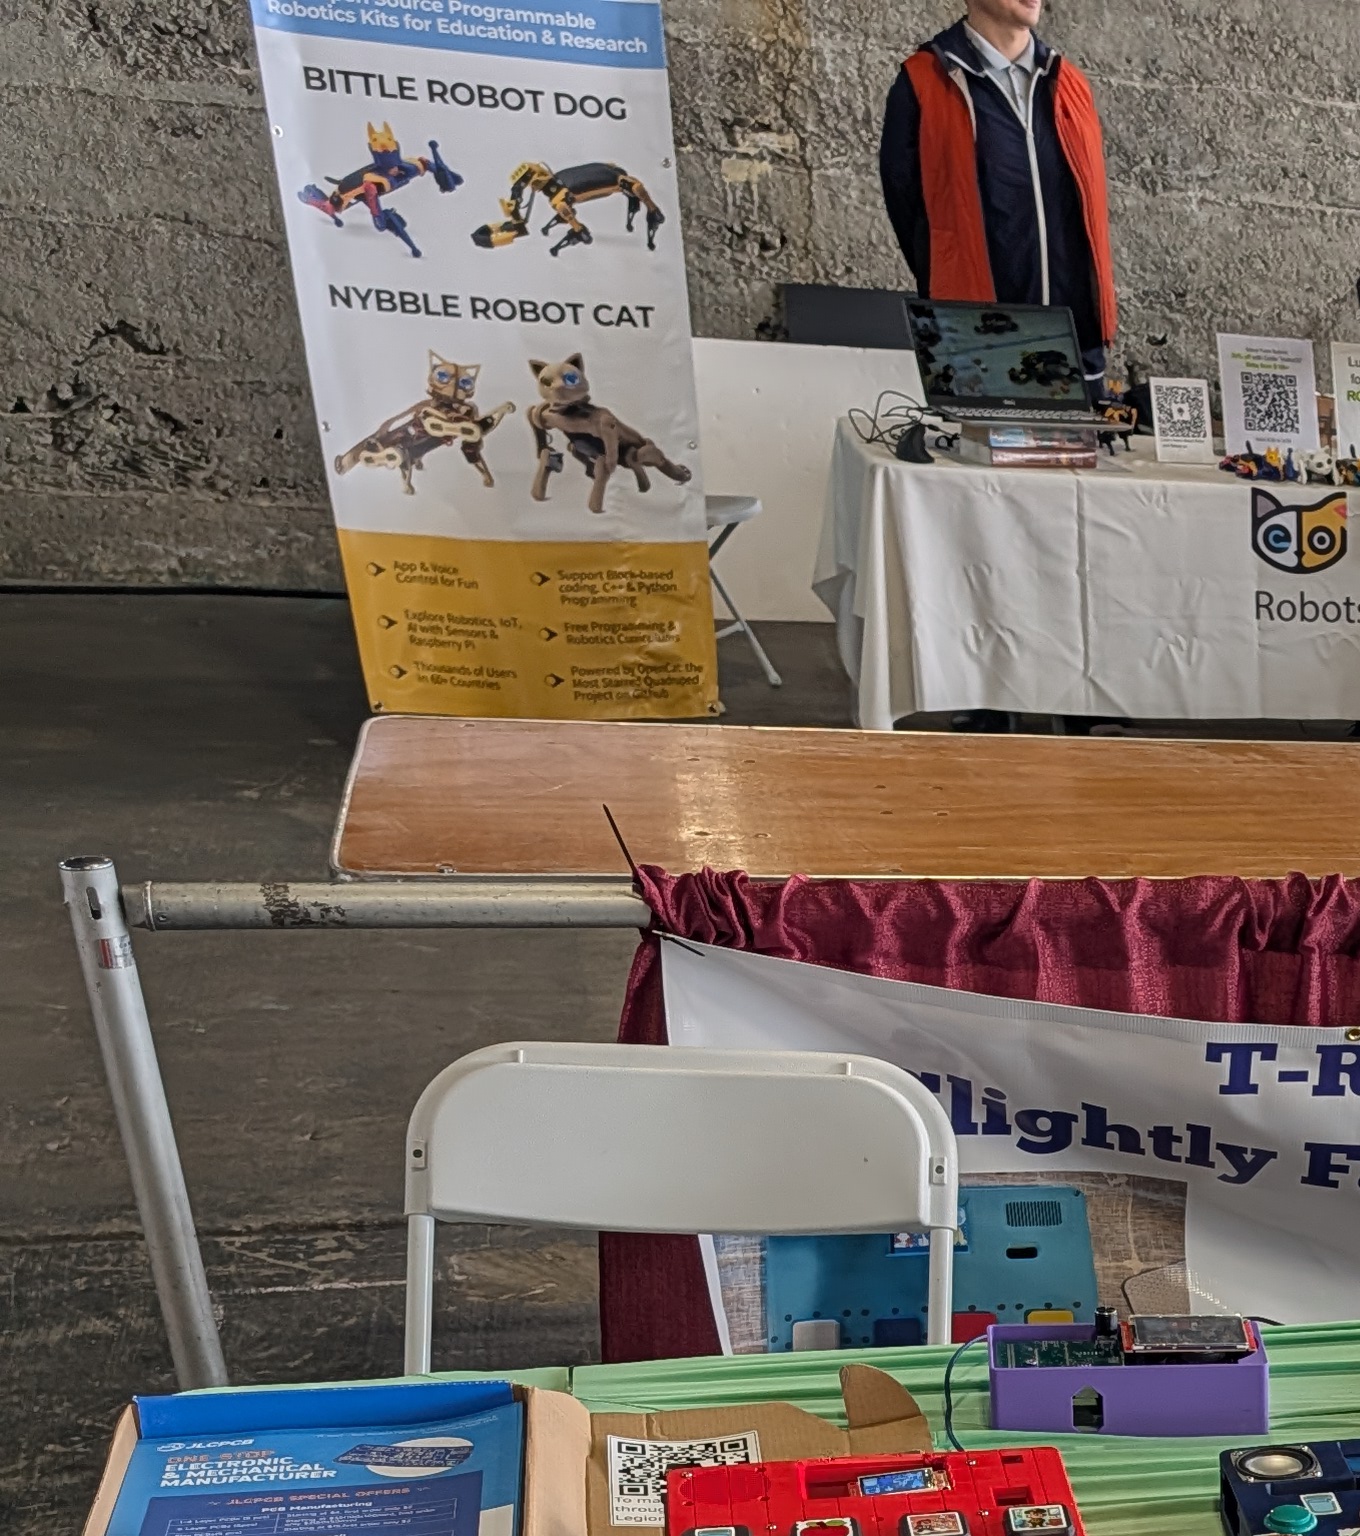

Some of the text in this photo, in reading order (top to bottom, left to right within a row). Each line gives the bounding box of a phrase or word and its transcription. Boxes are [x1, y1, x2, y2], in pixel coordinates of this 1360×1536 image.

[448, 1, 597, 30] Programmable
[267, 1, 648, 54] Robotics Kits for Education & Research
[303, 66, 628, 120] BITTLE ROBOT DOG
[328, 284, 655, 329] NYBBLE ROBOT CAT
[186, 1439, 254, 1449] JLCPCB
[165, 1456, 294, 1472] ELECTRONIC
[186, 1463, 325, 1478] MECHANICAL
[160, 1470, 337, 1487] MANUFACTURER
[225, 1487, 411, 1506] JLCPCB SPECIAL OFFERS
[614, 1496, 632, 1504] To
[289, 1501, 373, 1511] Manufacturing
[615, 1506, 664, 1515] throug
